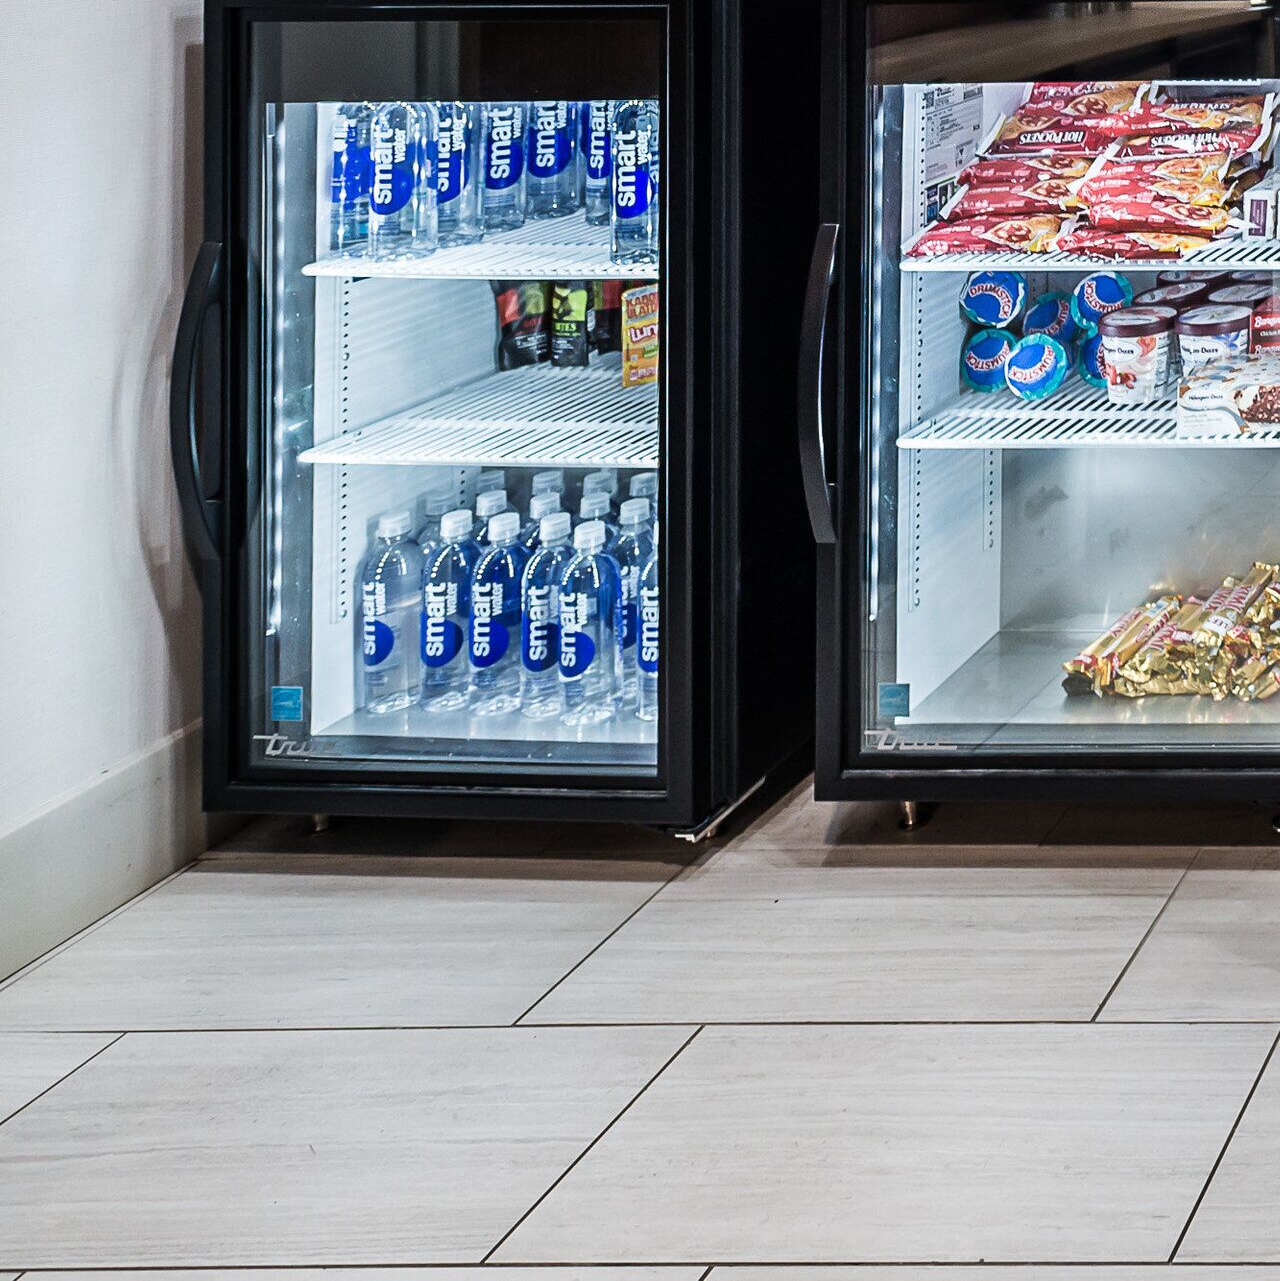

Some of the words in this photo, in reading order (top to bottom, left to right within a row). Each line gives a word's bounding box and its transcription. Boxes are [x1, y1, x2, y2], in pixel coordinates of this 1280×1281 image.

[489, 107, 513, 179] smart
[511, 106, 522, 139] water
[616, 130, 637, 207] smart
[969, 283, 1013, 320] DRUMSTICK
[966, 340, 1010, 371] RUMSTICK
[1010, 345, 1056, 384] RUMSTICK
[426, 582, 446, 657] smart
[447, 582, 457, 616] water
[472, 582, 491, 657] smart
[492, 582, 504, 616] water
[528, 585, 549, 660] smart
[559, 592, 576, 667] smart
[640, 586, 659, 662] smart
